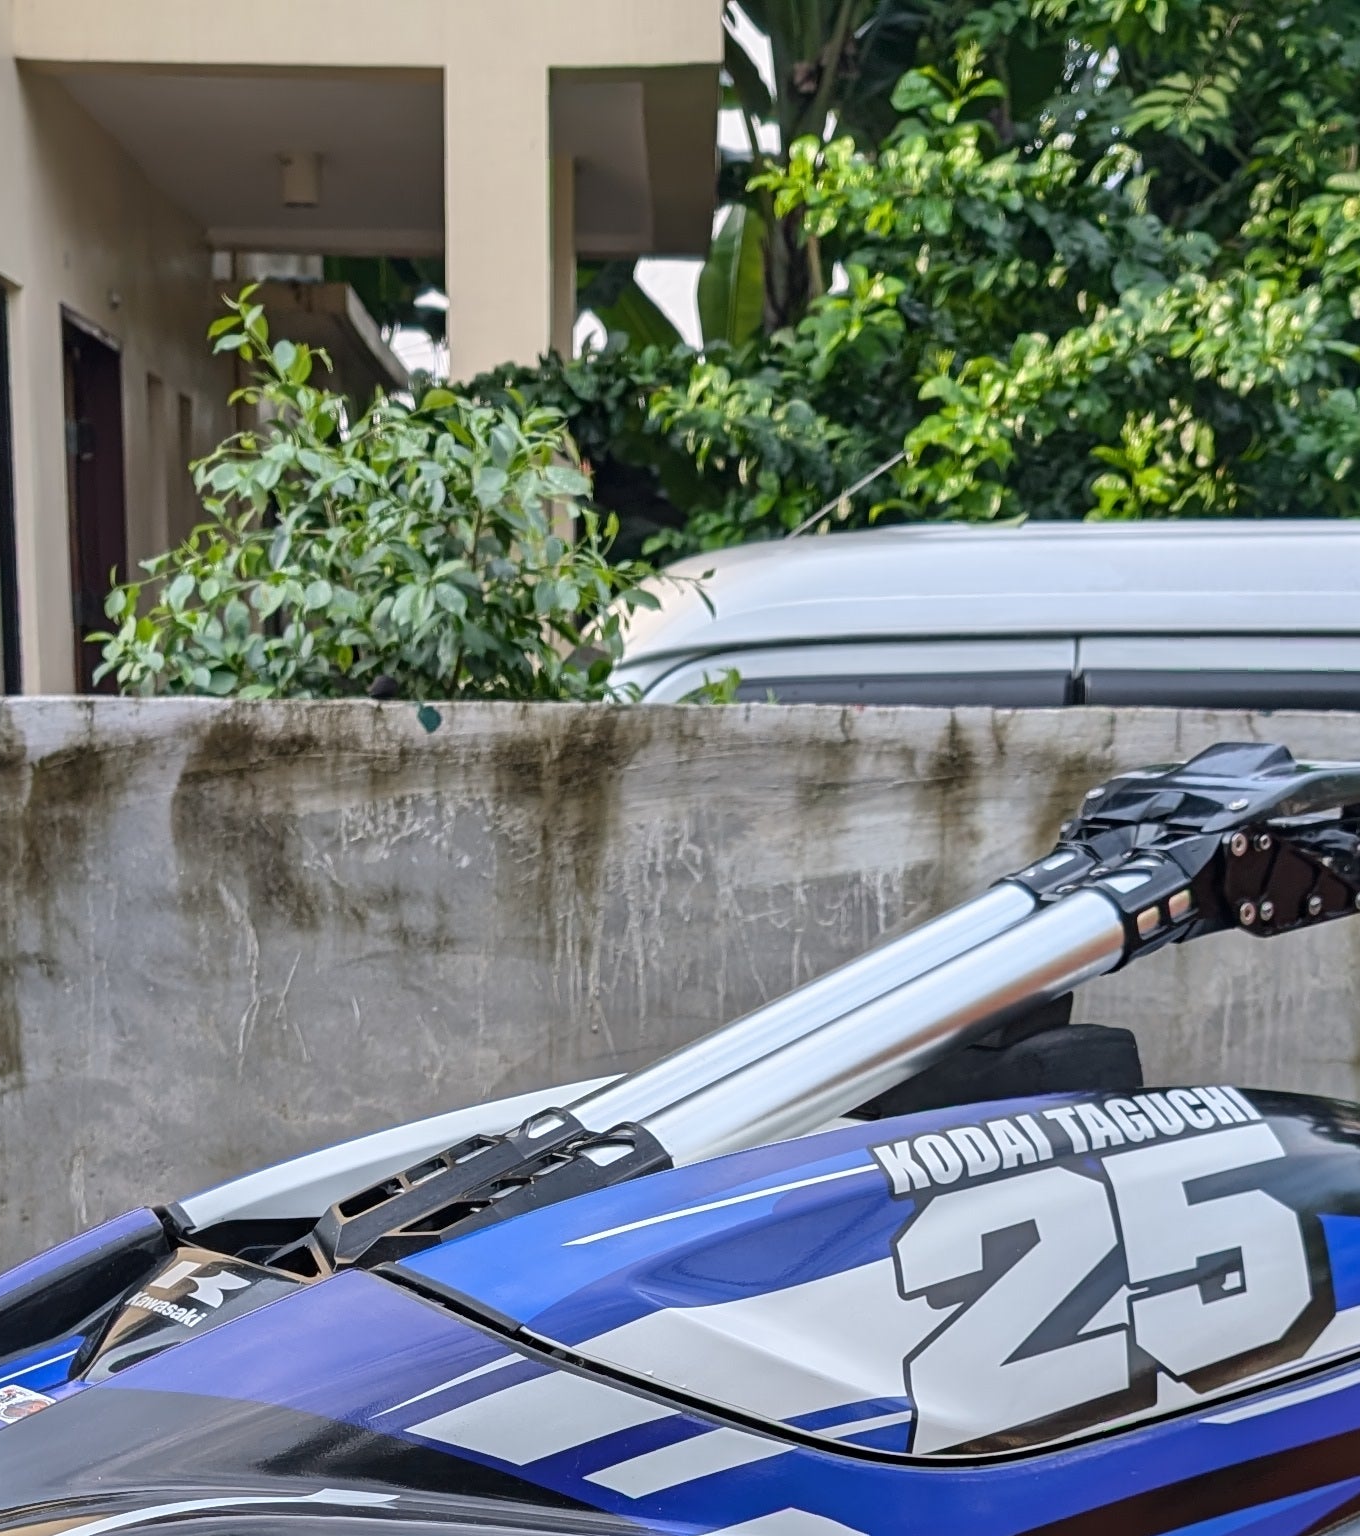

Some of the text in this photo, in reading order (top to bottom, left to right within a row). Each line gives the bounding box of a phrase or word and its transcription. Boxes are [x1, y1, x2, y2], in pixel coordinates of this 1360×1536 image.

[873, 1085, 1263, 1195] KODAI TAGUCHI
[124, 1290, 208, 1328] Kawasaki
[897, 1124, 1311, 1455] 25
